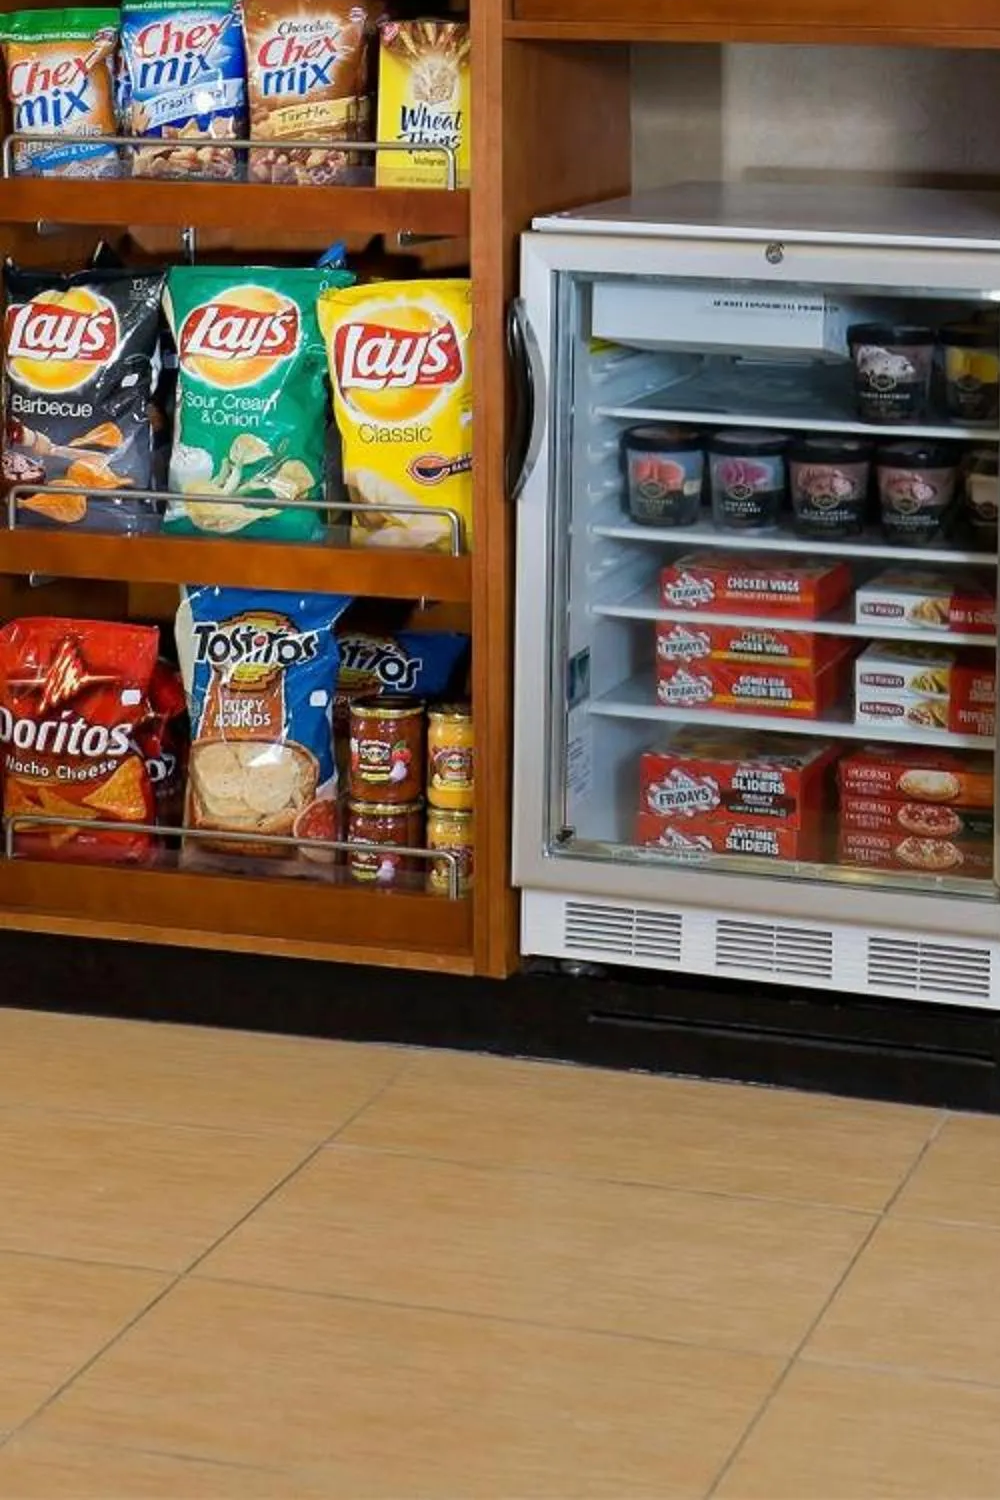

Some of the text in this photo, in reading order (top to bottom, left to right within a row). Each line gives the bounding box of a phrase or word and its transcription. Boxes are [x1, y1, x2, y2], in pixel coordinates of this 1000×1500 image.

[135, 16, 229, 59] Chex
[257, 31, 341, 69] Chex
[9, 54, 92, 100] Chex
[138, 50, 217, 90] mix
[263, 56, 336, 97] mix
[16, 77, 91, 129] mix
[153, 82, 227, 114] Traditnal
[400, 102, 463, 132] Wheat
[341, 324, 453, 389] Lay's
[12, 394, 94, 418] Barbecue
[186, 390, 278, 412] Sour Cream
[201, 410, 261, 428] & Onion
[358, 423, 433, 445] Classic
[193, 622, 320, 667] Tostitos
[6, 755, 118, 781] Nacho Cheese
[658, 786, 711, 806] FRIDAYS
[731, 777, 785, 795] SLIDERS
[725, 838, 780, 855] SLIDERS
